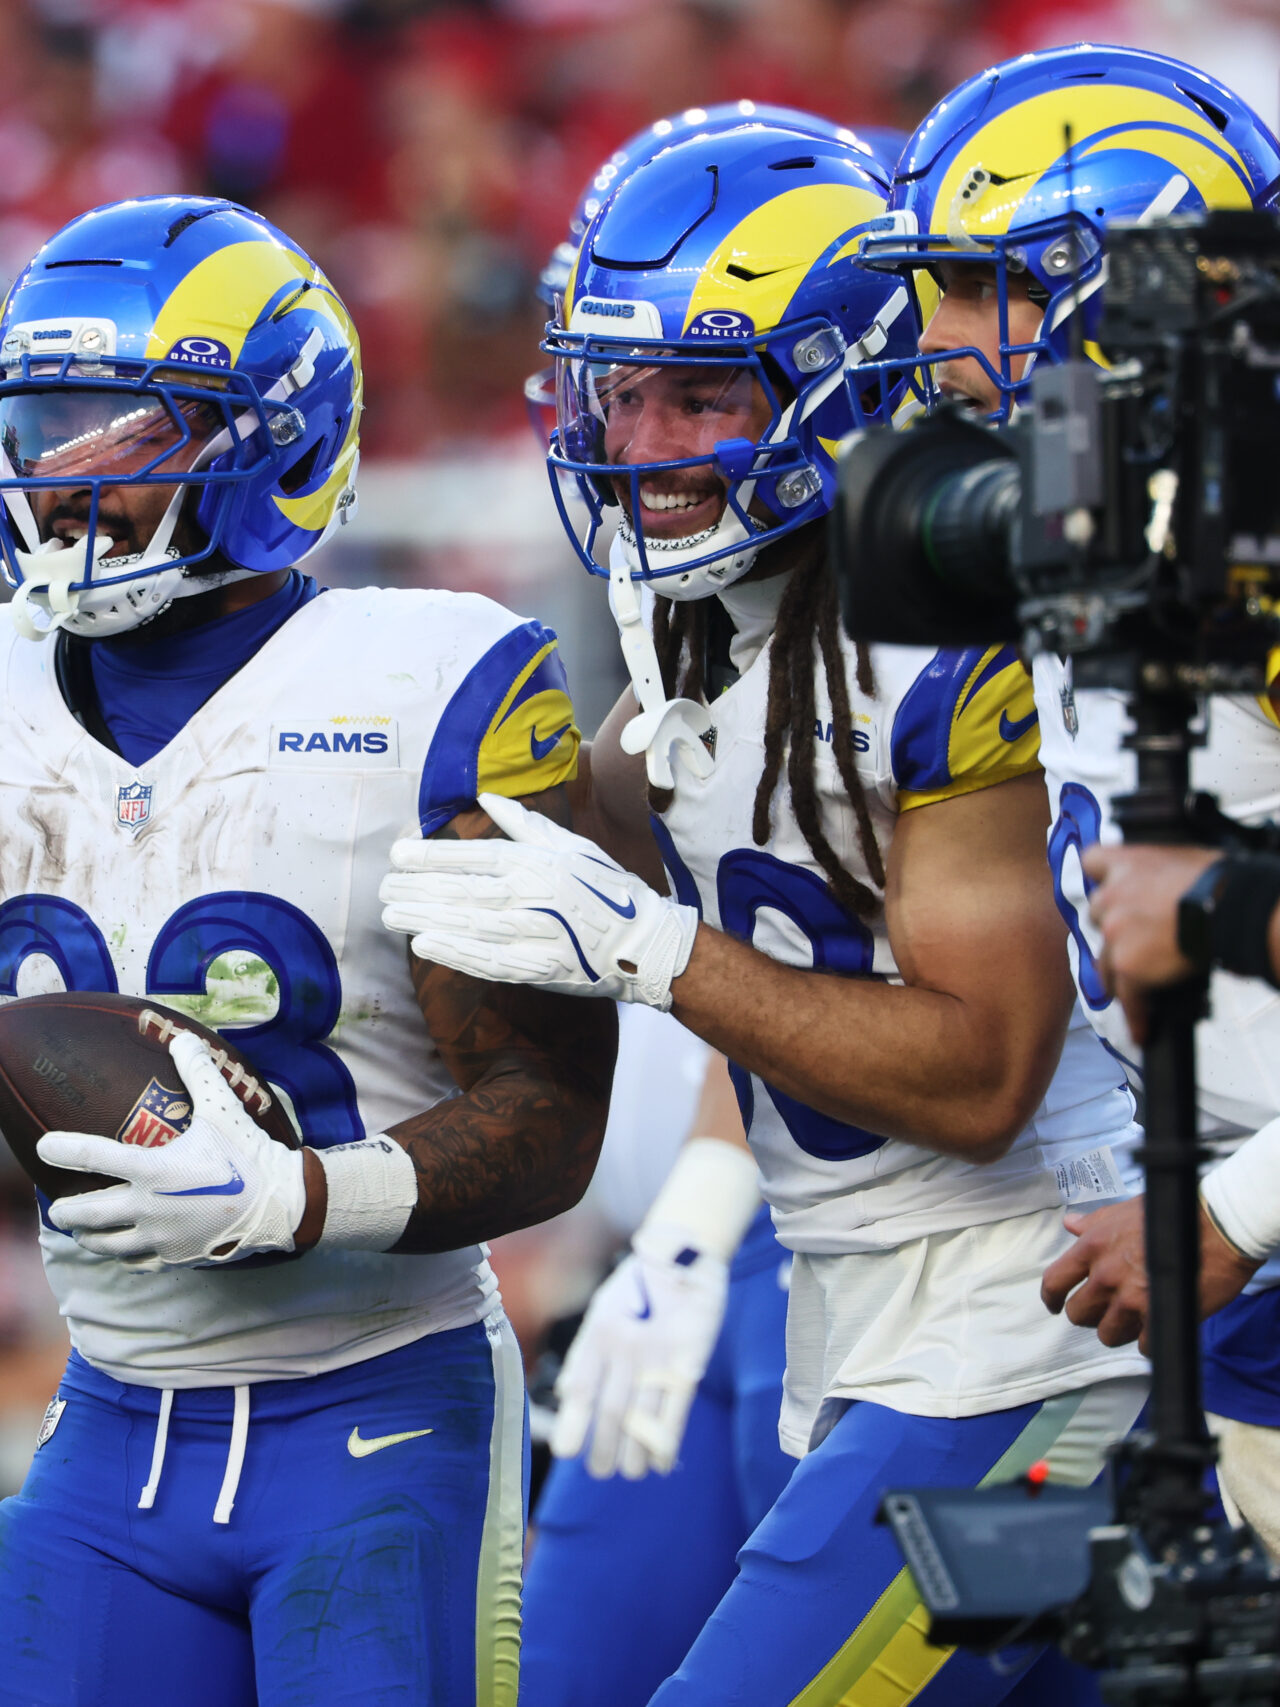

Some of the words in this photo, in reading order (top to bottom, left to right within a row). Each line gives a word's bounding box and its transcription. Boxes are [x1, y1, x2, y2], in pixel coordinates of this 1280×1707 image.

[580, 300, 636, 319] RAMS
[32, 329, 73, 340] RAMS
[691, 327, 750, 338] OAKLEY
[170, 352, 227, 367] OAKLEY
[278, 732, 389, 754] RAMS
[120, 800, 148, 822] NFL
[124, 1111, 183, 1148] NF
